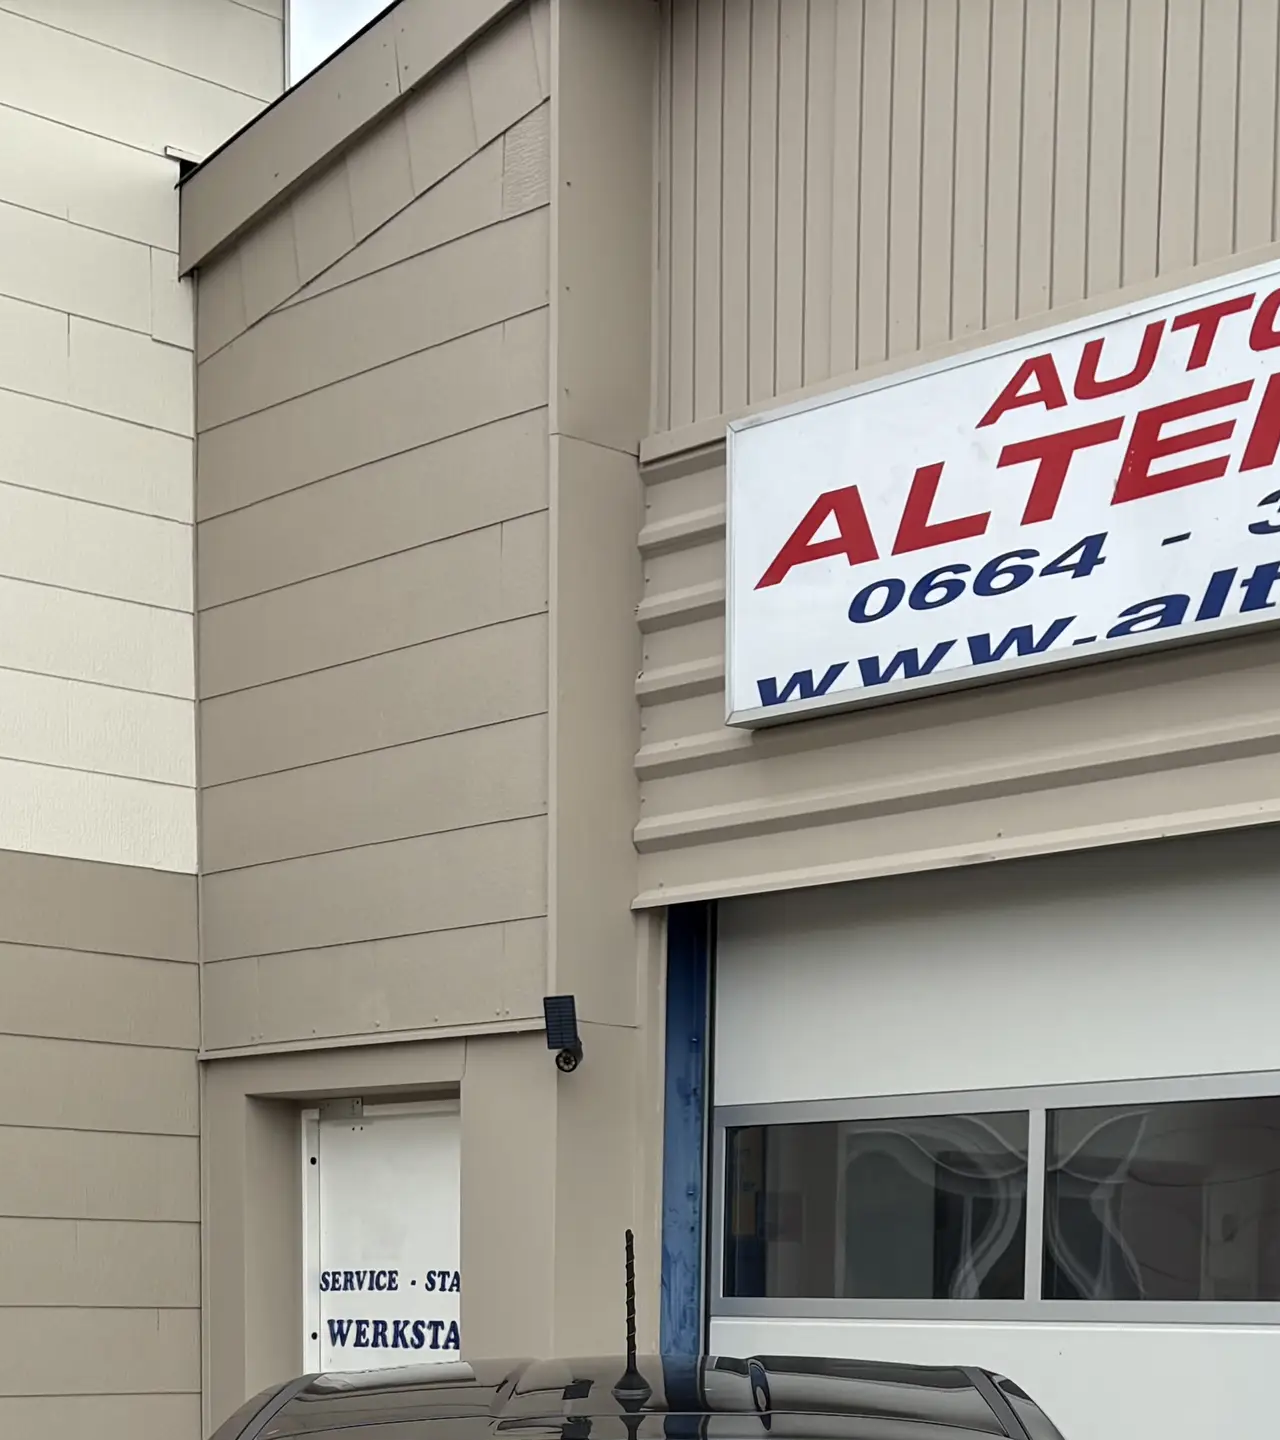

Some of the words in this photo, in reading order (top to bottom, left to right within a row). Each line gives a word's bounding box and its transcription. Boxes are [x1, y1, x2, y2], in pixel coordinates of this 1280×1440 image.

[848, 532, 1108, 625] 0664
[320, 1270, 399, 1292] SERVICE
[424, 1270, 461, 1293] STA
[327, 1318, 461, 1350] WERKSTA
